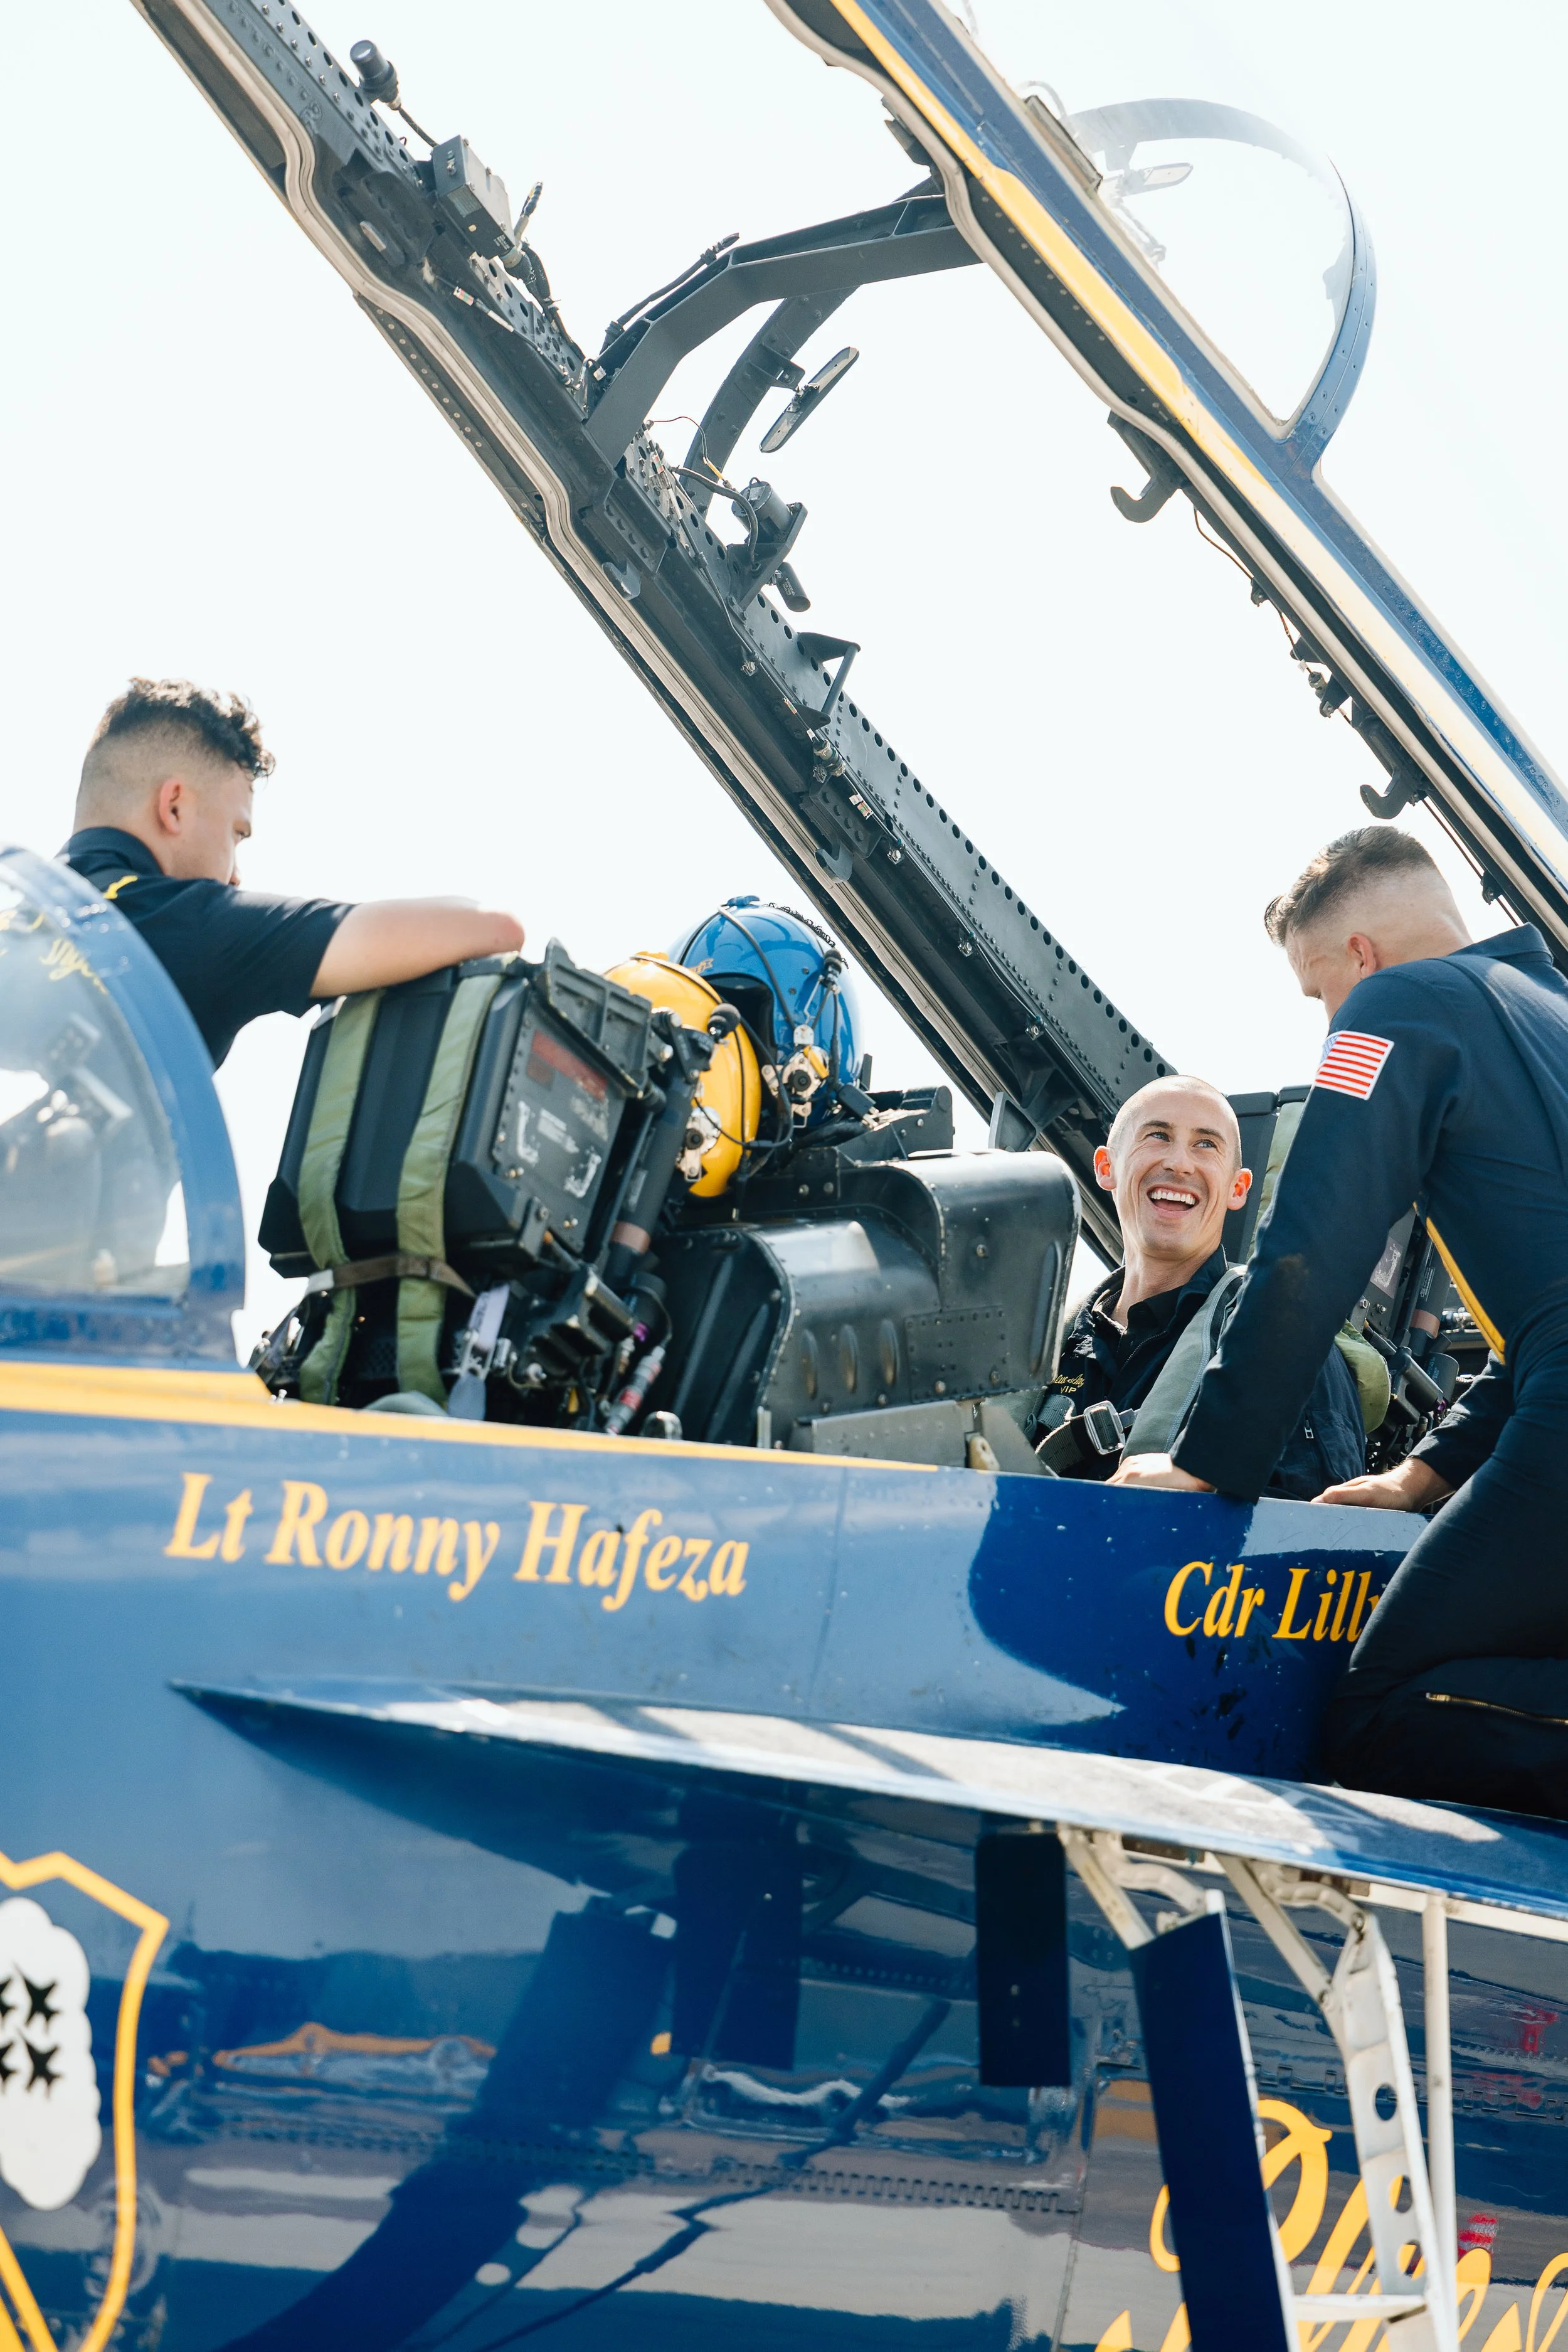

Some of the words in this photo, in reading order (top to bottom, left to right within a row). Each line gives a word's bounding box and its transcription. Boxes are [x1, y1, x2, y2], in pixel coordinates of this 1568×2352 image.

[1054, 1374, 1069, 1384] lue
[163, 1472, 253, 1562] Lt
[265, 1480, 500, 1601] Ronny
[514, 1501, 750, 1611] Hafeza
[1163, 1560, 1266, 1637] Cdr
